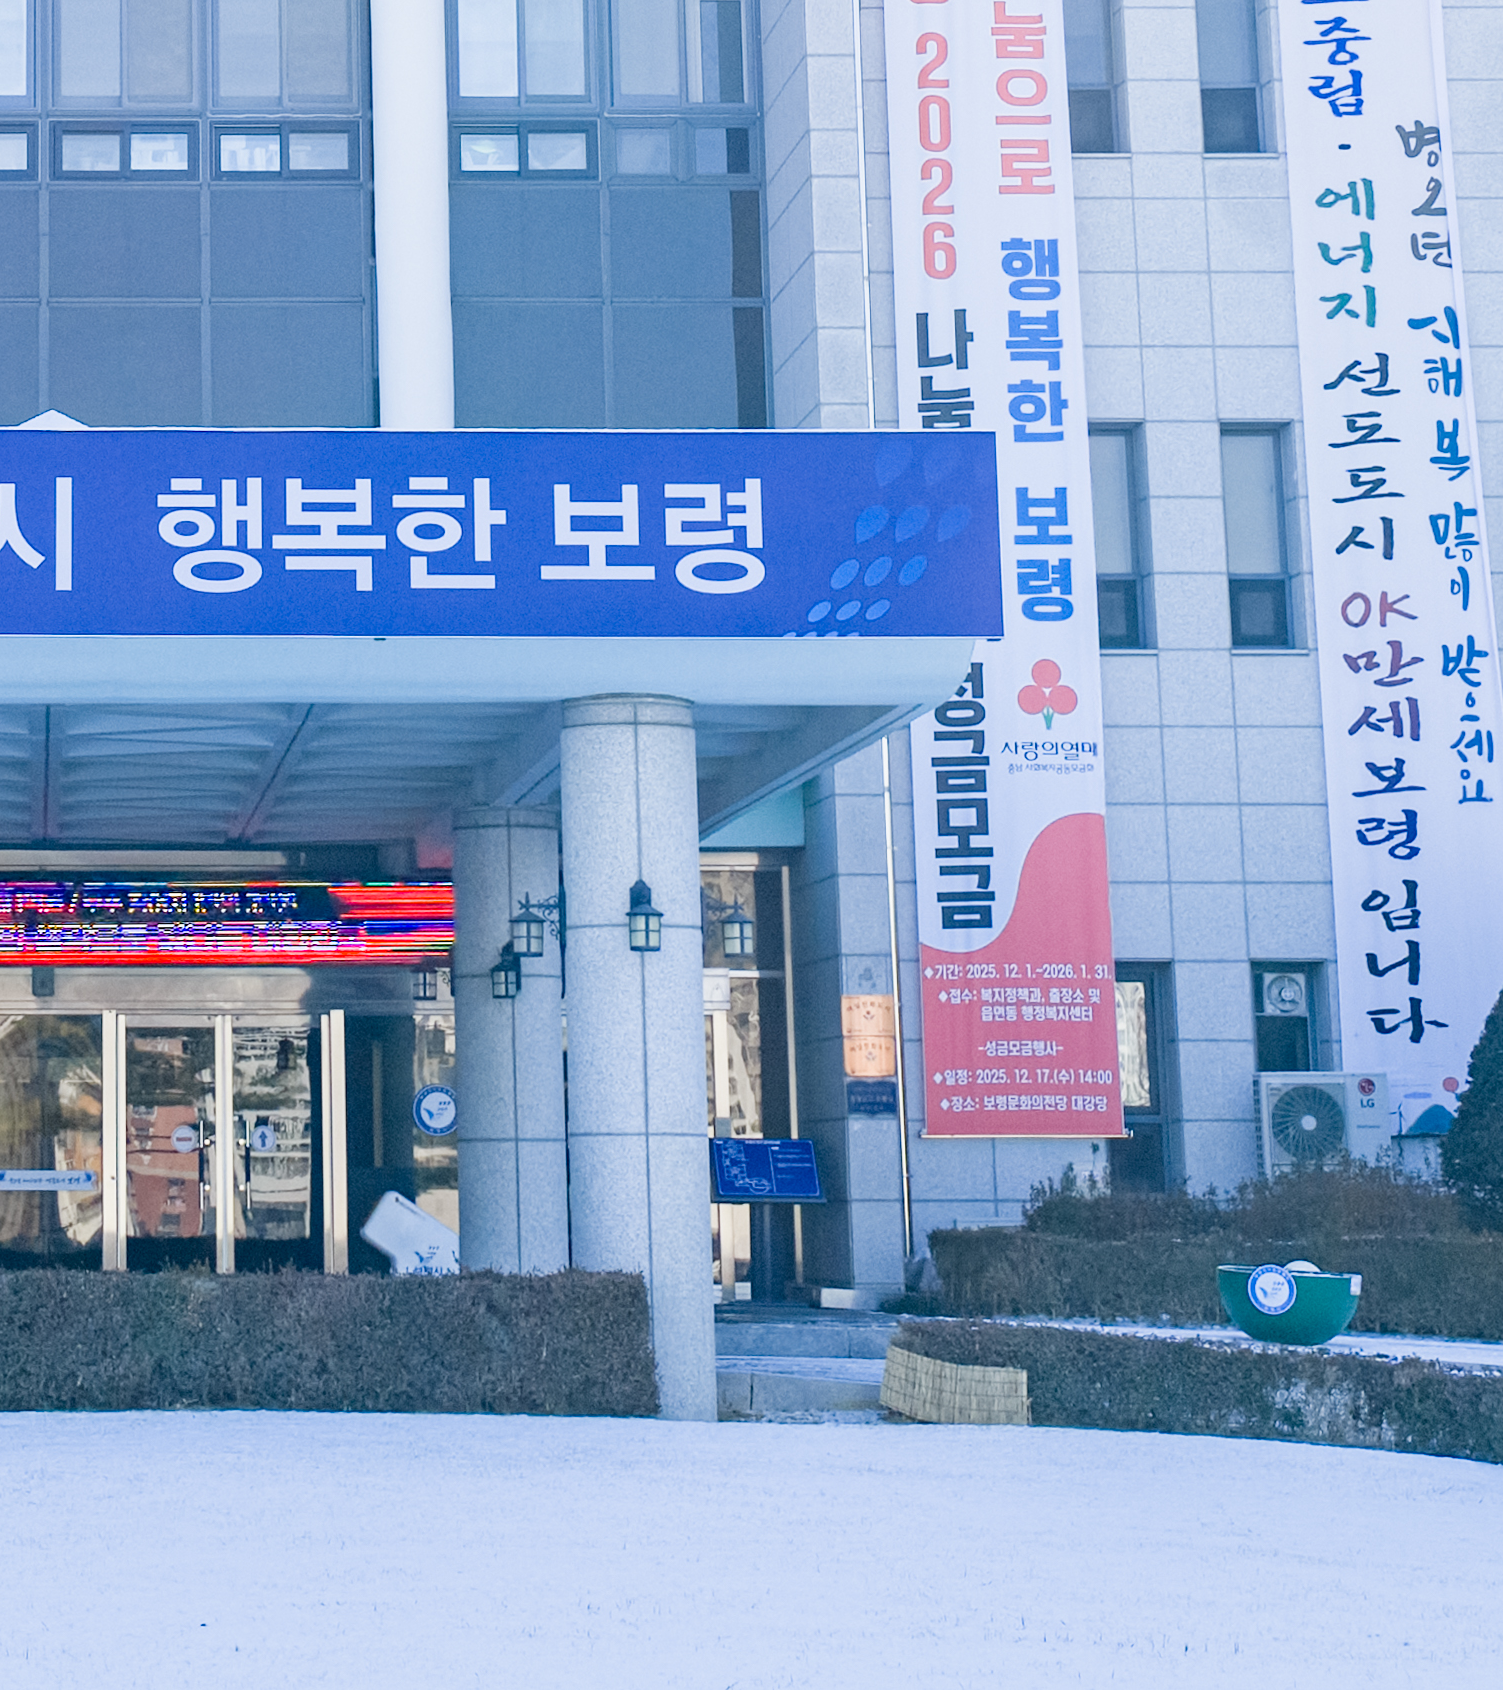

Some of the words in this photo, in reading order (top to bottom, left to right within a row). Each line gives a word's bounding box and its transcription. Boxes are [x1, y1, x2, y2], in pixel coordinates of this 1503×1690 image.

[915, 32, 957, 280] 2026
[1396, 120, 1453, 269] 병오년
[915, 308, 975, 428] 나눔
[1001, 236, 1070, 444] 행복한
[1429, 417, 1471, 481] 복
[157, 476, 508, 595] 행복한
[540, 478, 767, 595] 보령
[1015, 486, 1075, 624] 보령
[1430, 501, 1480, 612] 많이
[1441, 635, 1495, 805] 받으세요
[935, 964, 963, 980] 기간:
[966, 964, 1000, 979] 2025.
[1003, 964, 1022, 979] 12.
[1080, 964, 1091, 979] 1.
[1094, 964, 1112, 979] 31.
[949, 988, 977, 1004] 접수:
[981, 987, 1045, 1003] 복지정책과,
[1049, 988, 1084, 1004] 출장소
[1089, 988, 1101, 1004] 및
[981, 1006, 1017, 1022] 읍면동
[1022, 1006, 1093, 1022] 행정복지센터
[944, 1069, 973, 1085] 일정:
[976, 1069, 1011, 1084] 2025.
[1014, 1069, 1032, 1084] 12.
[1078, 1069, 1113, 1084] 14:00
[978, 1041, 1064, 1056] -성금모금행사-
[951, 1096, 980, 1112] 장소:
[983, 1095, 1068, 1112] 보령문화의전당
[1071, 1095, 1107, 1112] 대강당
[1360, 1098, 1375, 1108] LG
